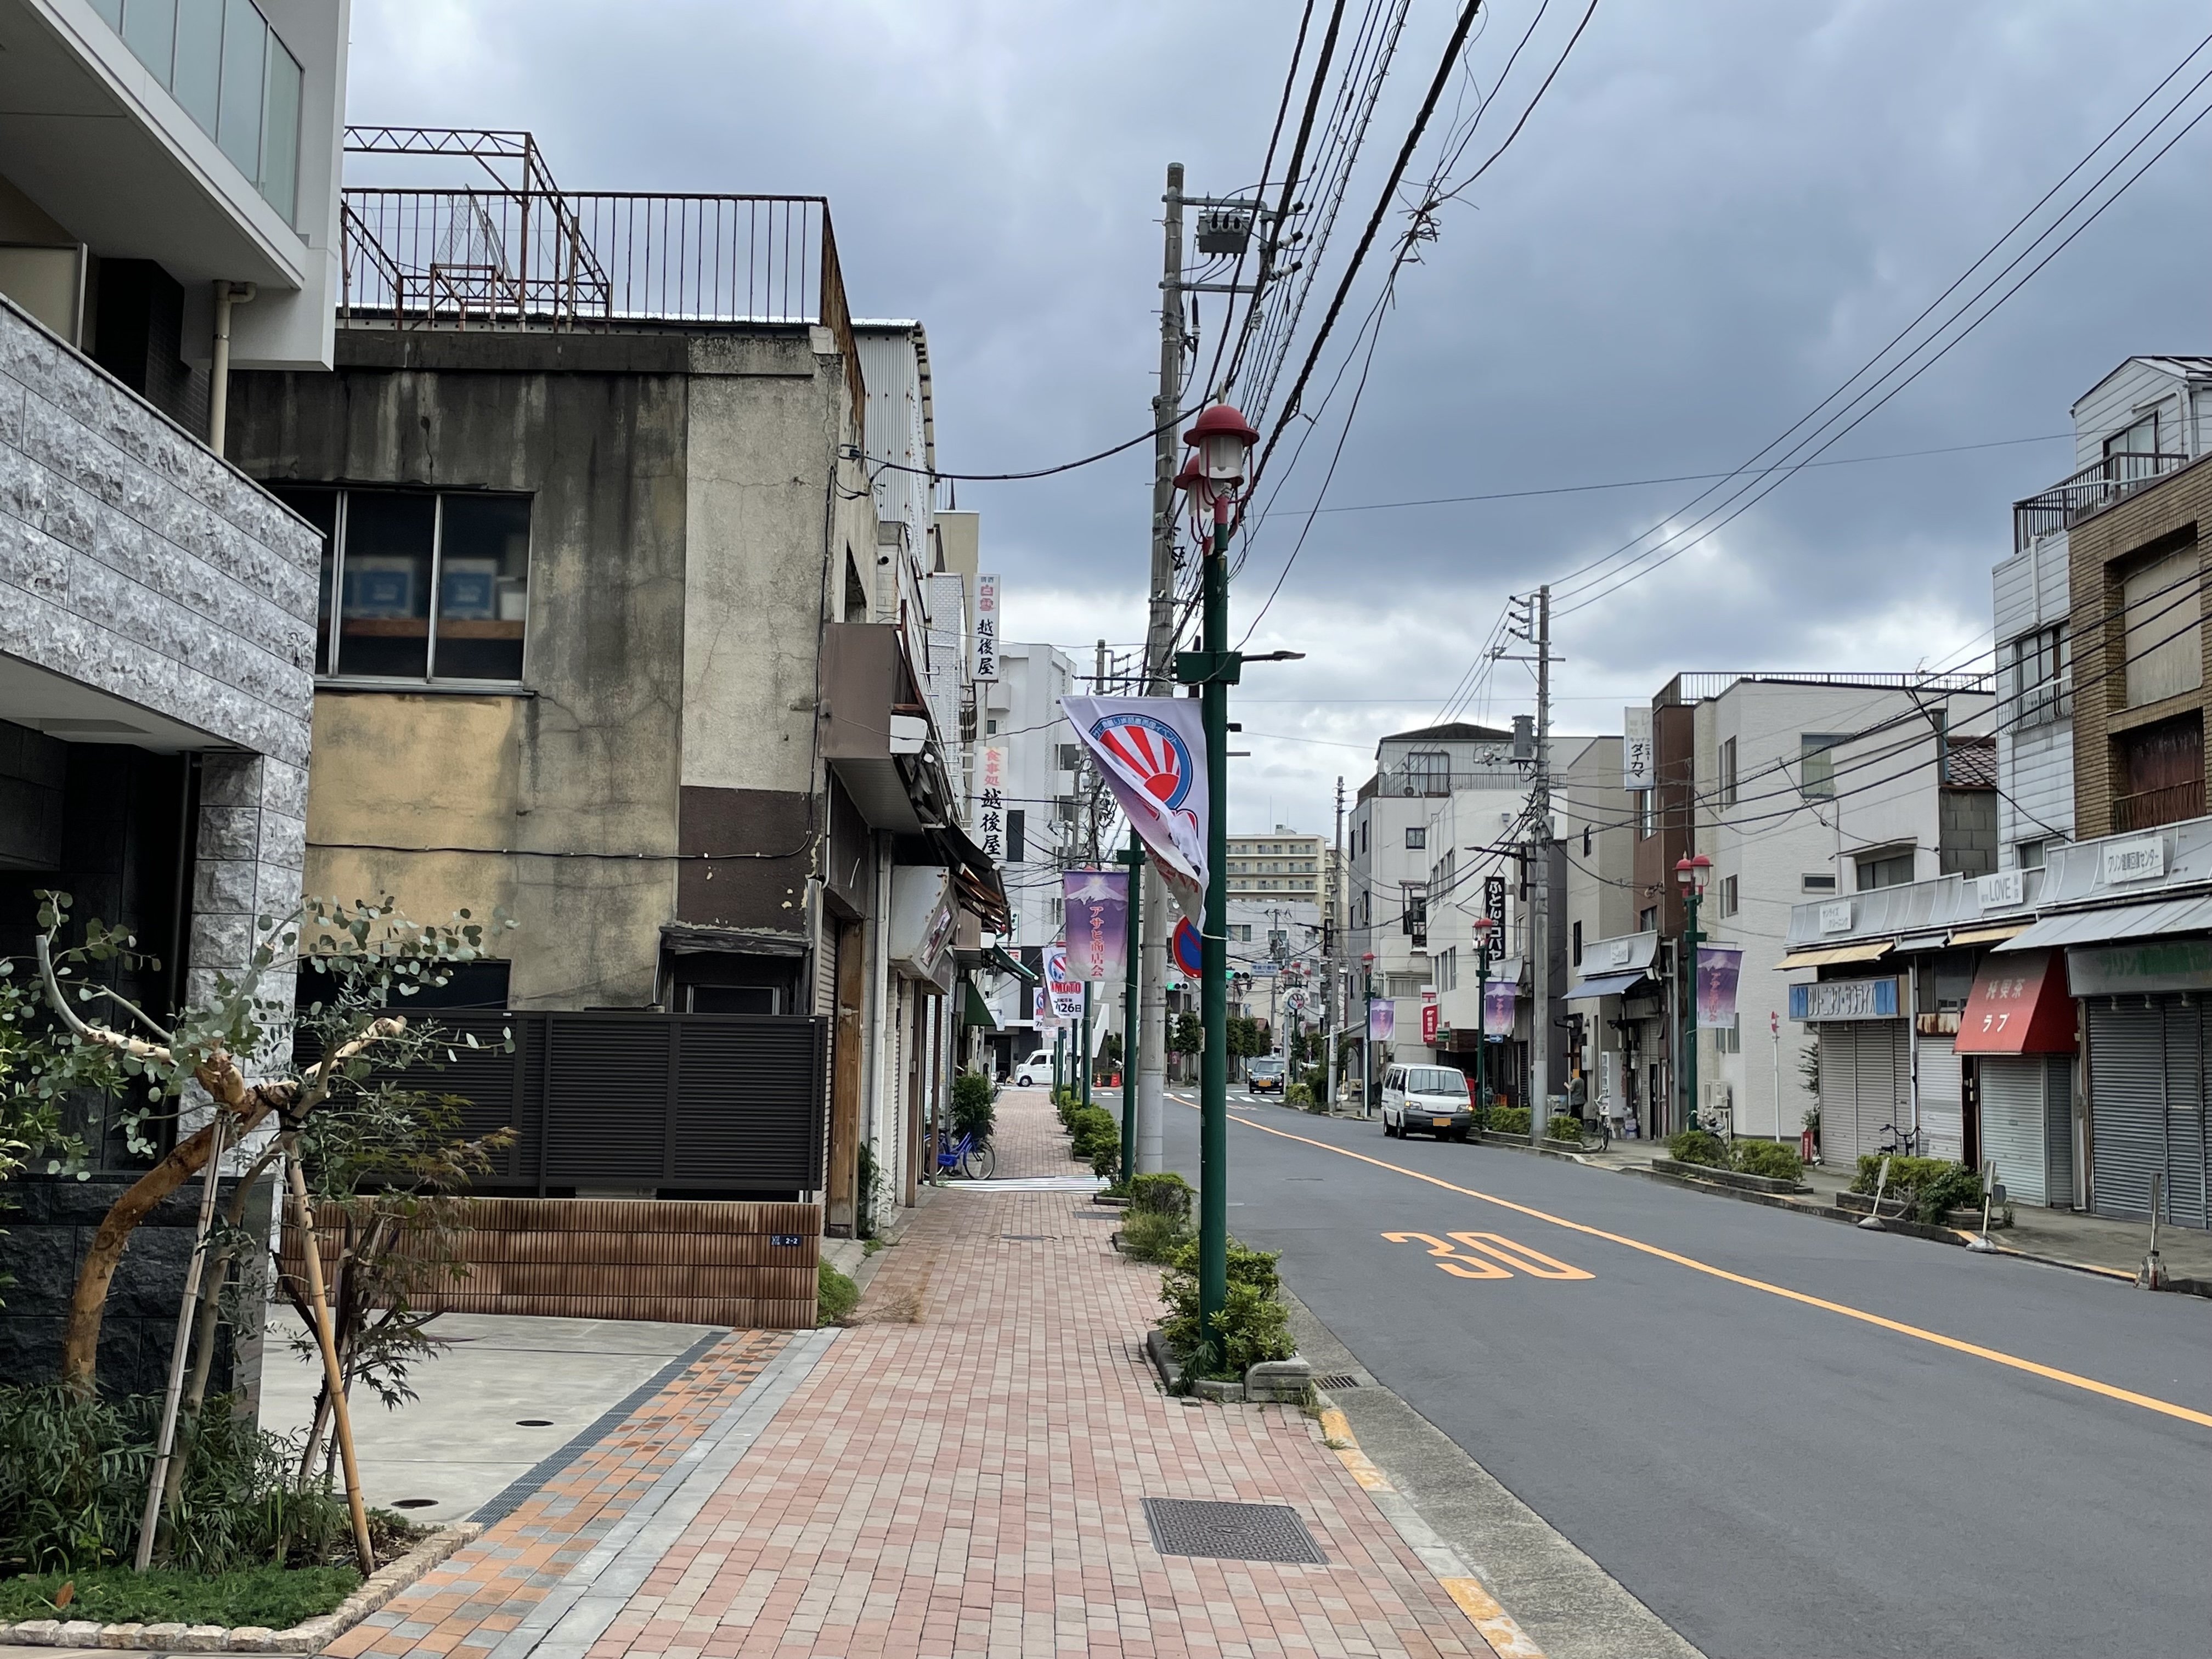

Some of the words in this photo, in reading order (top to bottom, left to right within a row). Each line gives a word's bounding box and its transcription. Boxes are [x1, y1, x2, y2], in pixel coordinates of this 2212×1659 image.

[978, 618, 995, 675] 越後屋
[984, 749, 1002, 787] 食事処
[979, 788, 1003, 855] 越後屋
[1989, 878, 2011, 902] LOVE
[1089, 906, 1104, 977] アサヒ商店会
[1983, 1013, 2010, 1032] ラブ
[1380, 1231, 1596, 1280] 30
